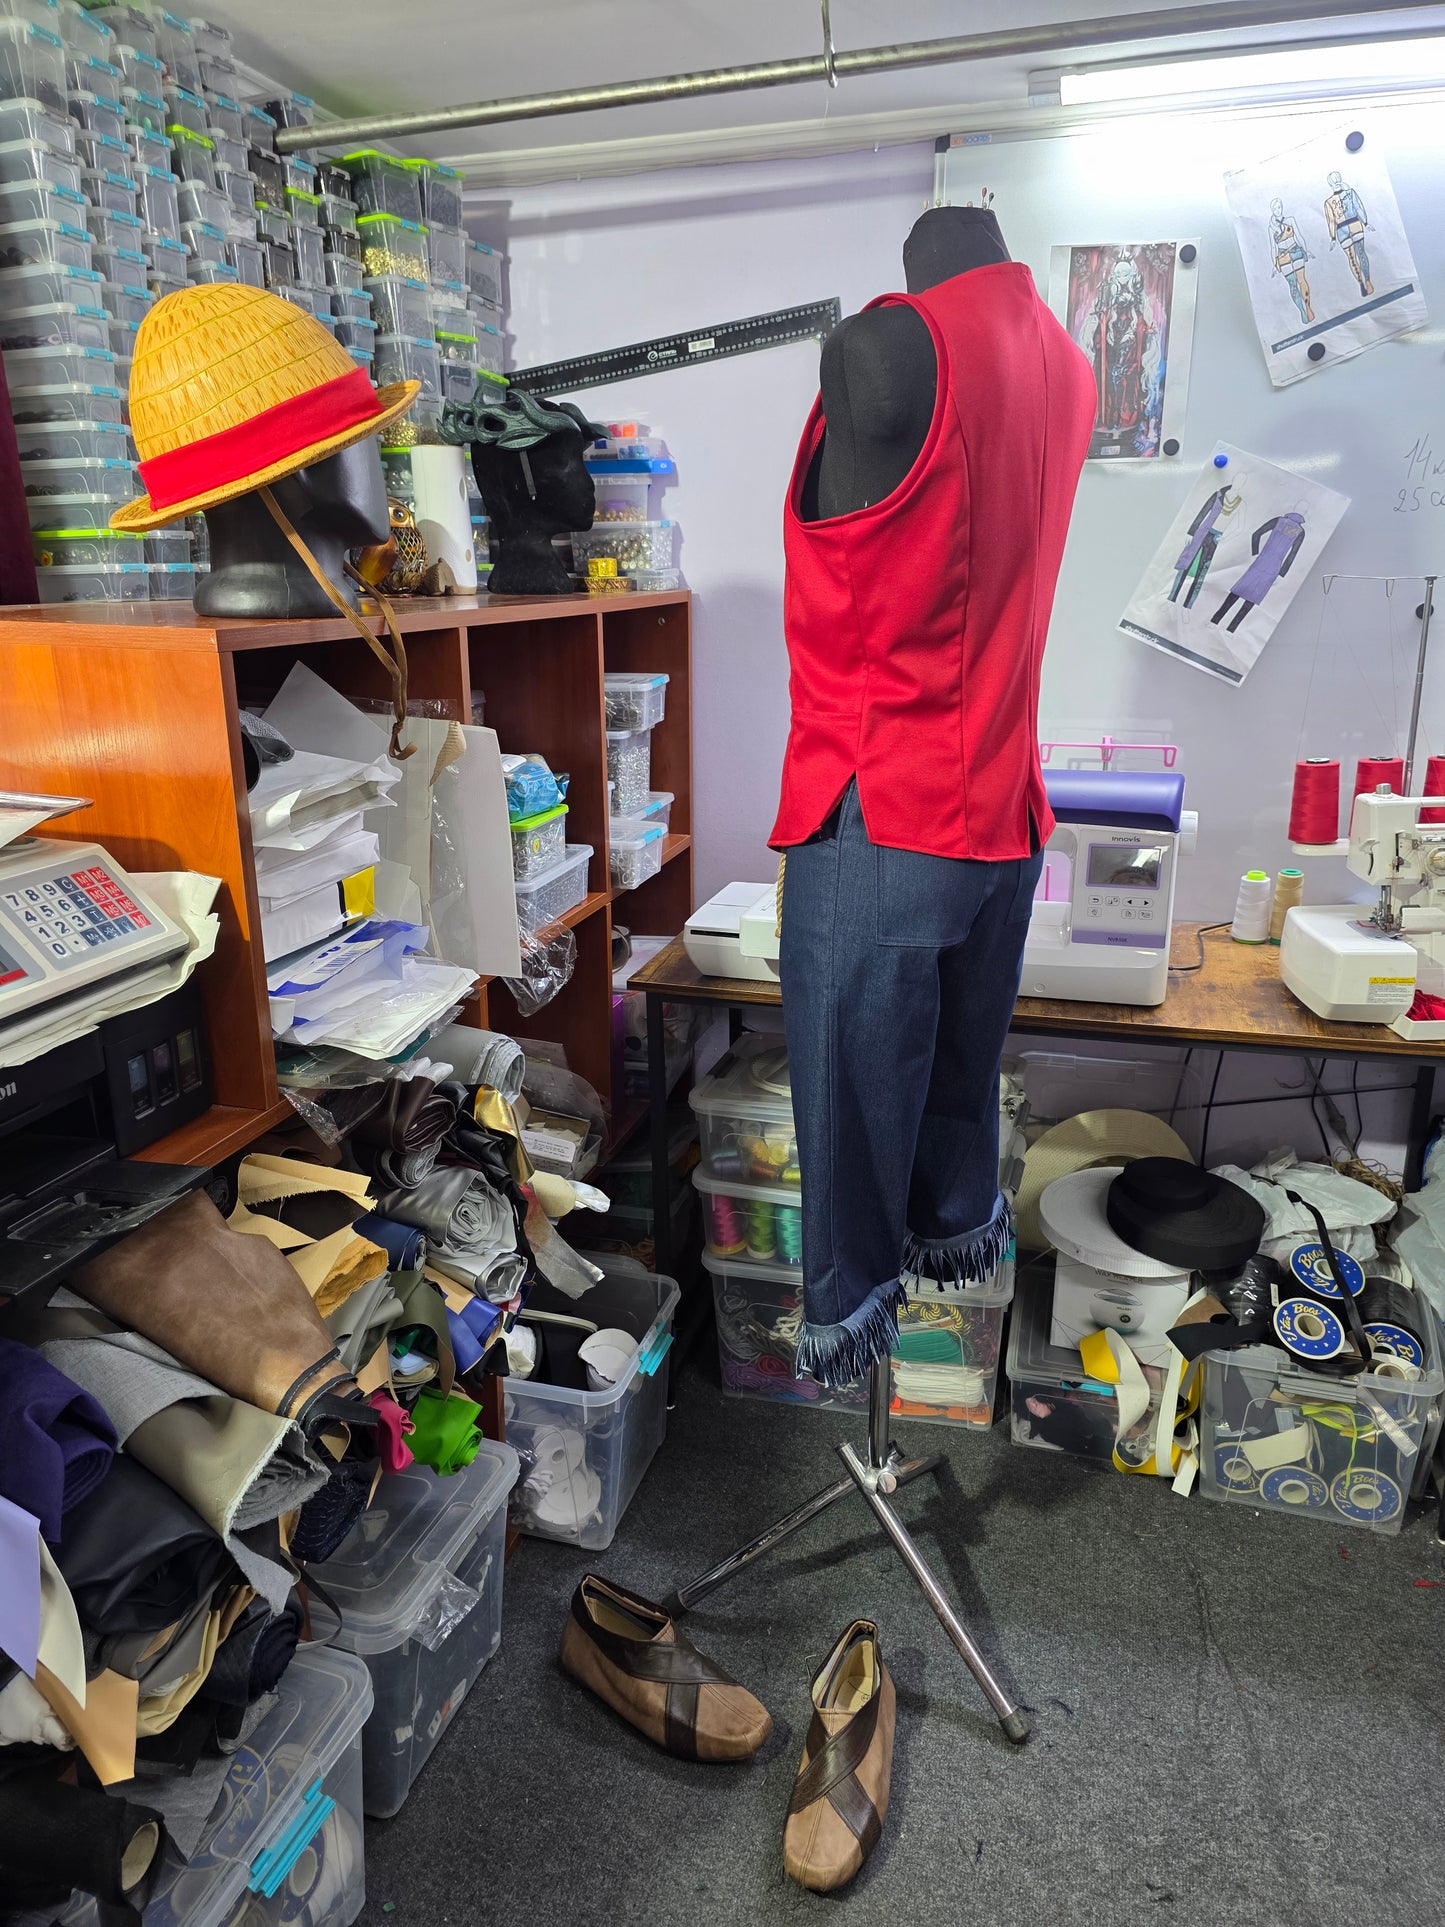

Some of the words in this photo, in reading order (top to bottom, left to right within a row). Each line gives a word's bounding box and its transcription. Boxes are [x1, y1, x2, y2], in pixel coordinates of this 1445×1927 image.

[1404, 433, 1432, 481] 14
[1393, 486, 1424, 512] 25
[5, 894, 19, 906] 7
[25, 889, 40, 901] 8
[43, 883, 57, 896] 9
[61, 880, 73, 889] C
[76, 874, 90, 886] M1
[92, 870, 107, 881] M2
[25, 910, 37, 922] 4
[40, 905, 54, 917] 5
[58, 899, 72, 912] 6
[89, 888, 106, 901] M3
[105, 884, 120, 896] M4
[39, 927, 51, 938] 1
[55, 921, 69, 934] 2
[72, 915, 86, 927] 3
[90, 910, 101, 919] T
[104, 903, 120, 917] M5
[52, 943, 67, 955] 0
[132, 914, 147, 927] M7
[1279, 1315, 1298, 1341] Star
[1292, 1303, 1319, 1316] Boos
[1366, 1330, 1393, 1343] tar
